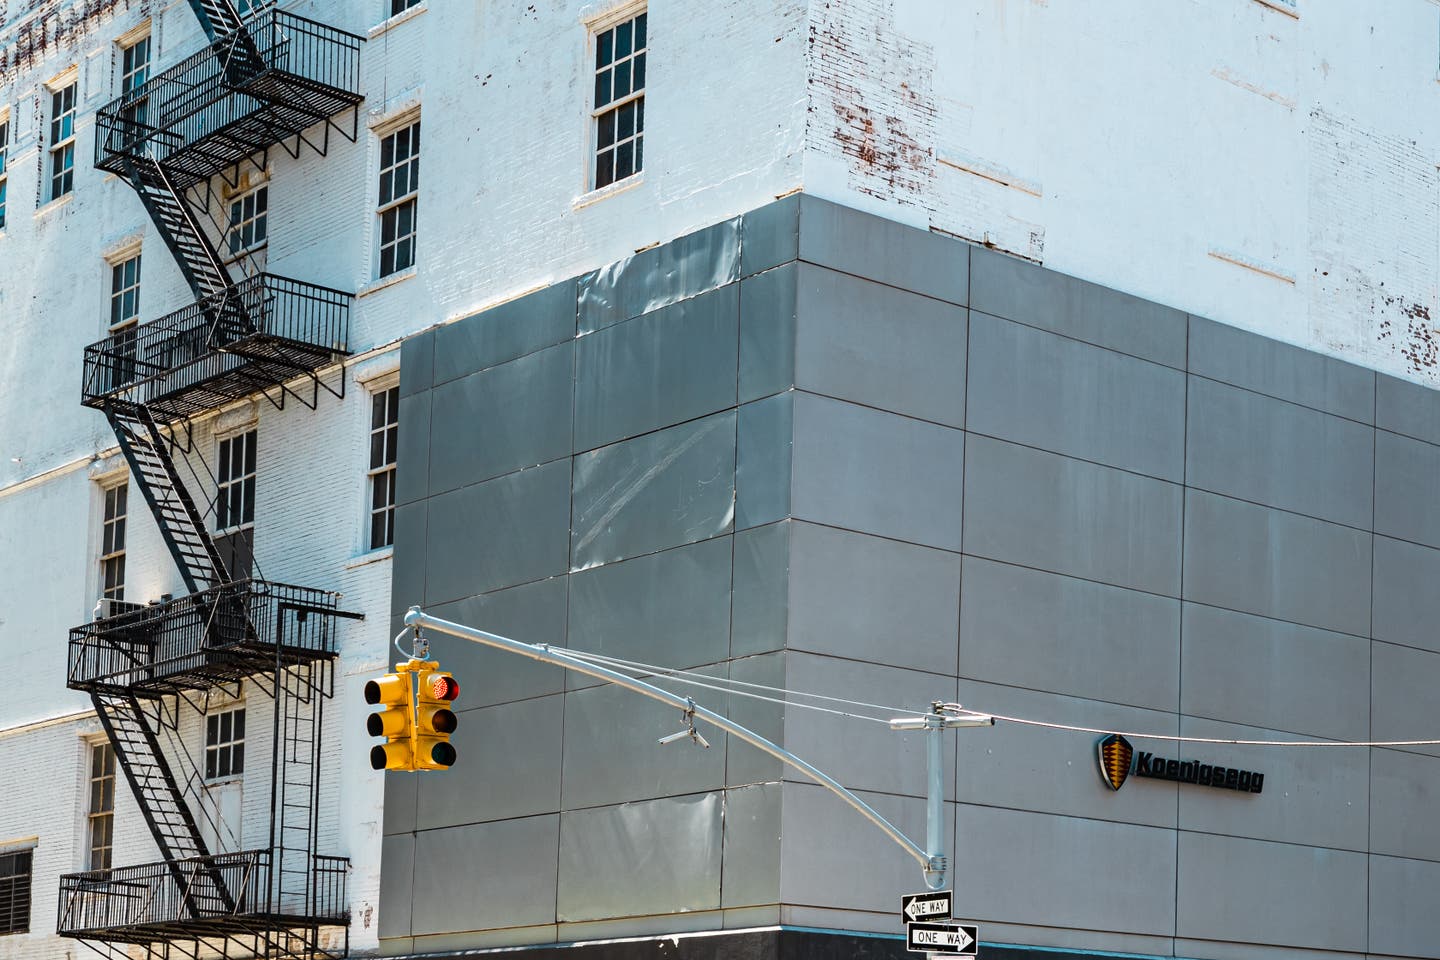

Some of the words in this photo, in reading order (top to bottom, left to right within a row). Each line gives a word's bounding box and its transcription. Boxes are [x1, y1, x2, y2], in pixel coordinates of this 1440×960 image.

[1136, 752, 1265, 793] Koenigsegg
[910, 902, 926, 915] ONE
[929, 900, 945, 913] WAY
[918, 931, 938, 944] ONE
[946, 933, 967, 945] WAY
